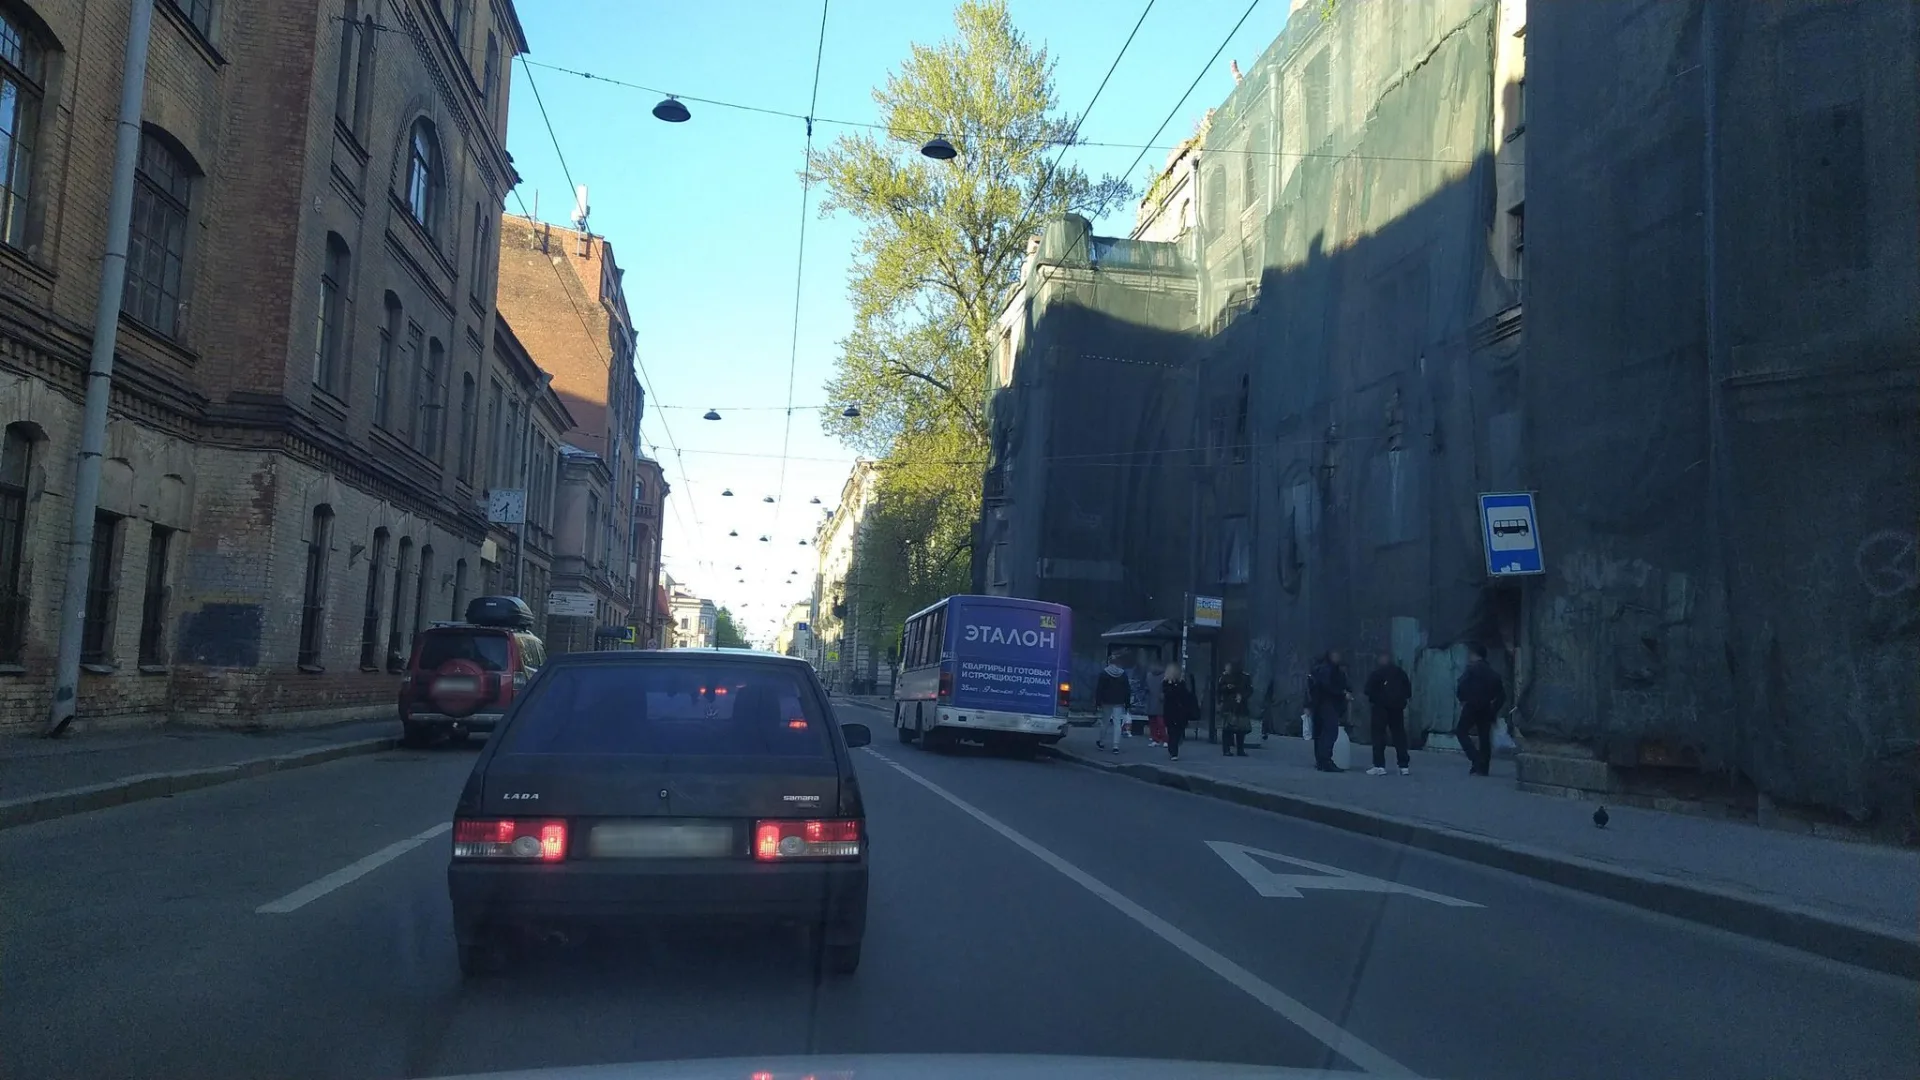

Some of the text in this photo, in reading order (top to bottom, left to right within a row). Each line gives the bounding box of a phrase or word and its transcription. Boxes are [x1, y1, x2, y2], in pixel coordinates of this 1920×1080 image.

[964, 625, 1054, 648] ЭТАЛОН
[962, 662, 1051, 677] КВАРТИРЫ В ГОТОВЫХ
[968, 672, 1022, 683] СТРОЯЩИХСЯ
[1022, 677, 1051, 685] ДОМАХ
